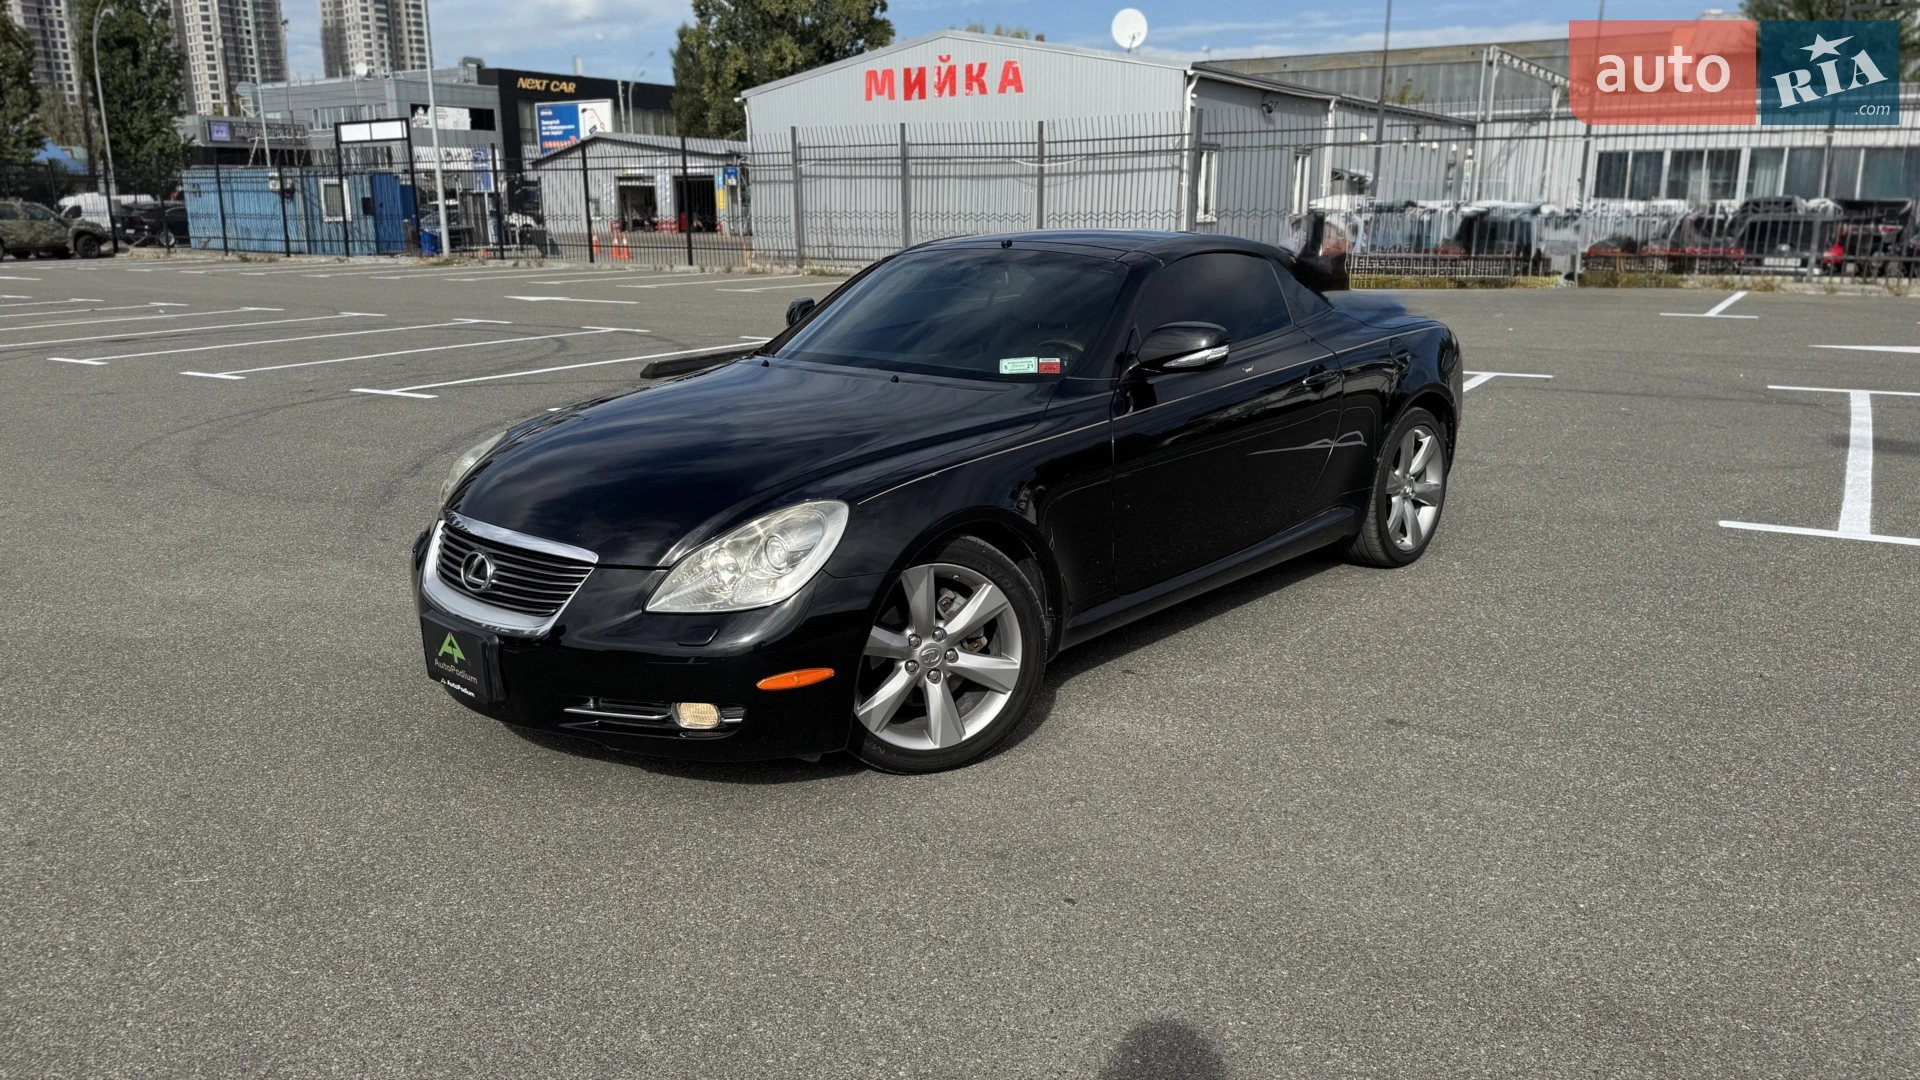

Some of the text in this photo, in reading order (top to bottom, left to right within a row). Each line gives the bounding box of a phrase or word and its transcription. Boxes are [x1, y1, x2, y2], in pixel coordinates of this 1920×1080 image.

[550, 80, 577, 93] CAR
[864, 54, 1025, 102] МИЙКА
[434, 658, 478, 684] AutoPodium
